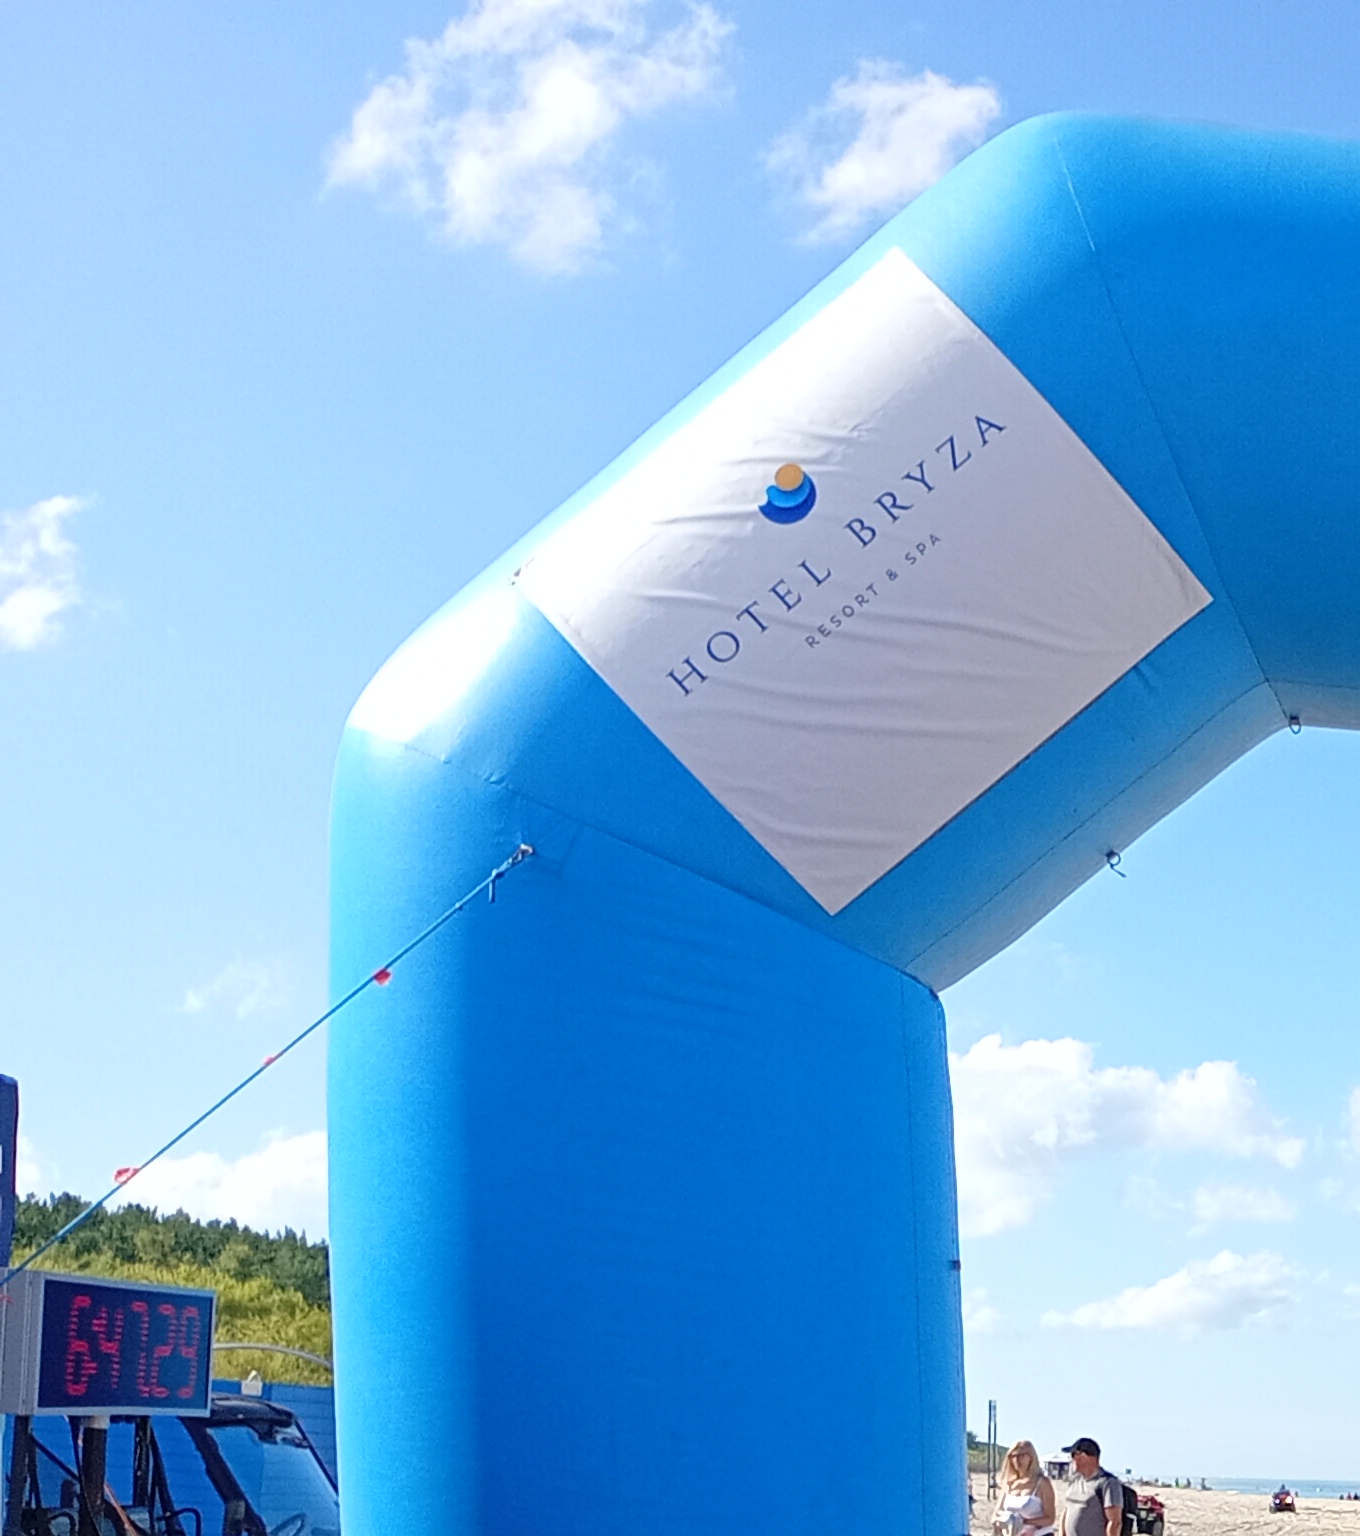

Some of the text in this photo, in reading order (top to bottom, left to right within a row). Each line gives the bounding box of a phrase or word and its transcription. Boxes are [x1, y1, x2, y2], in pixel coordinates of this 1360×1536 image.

[665, 414, 1007, 697] HOTEL BRYZA
[805, 532, 942, 649] RESORT & SPA
